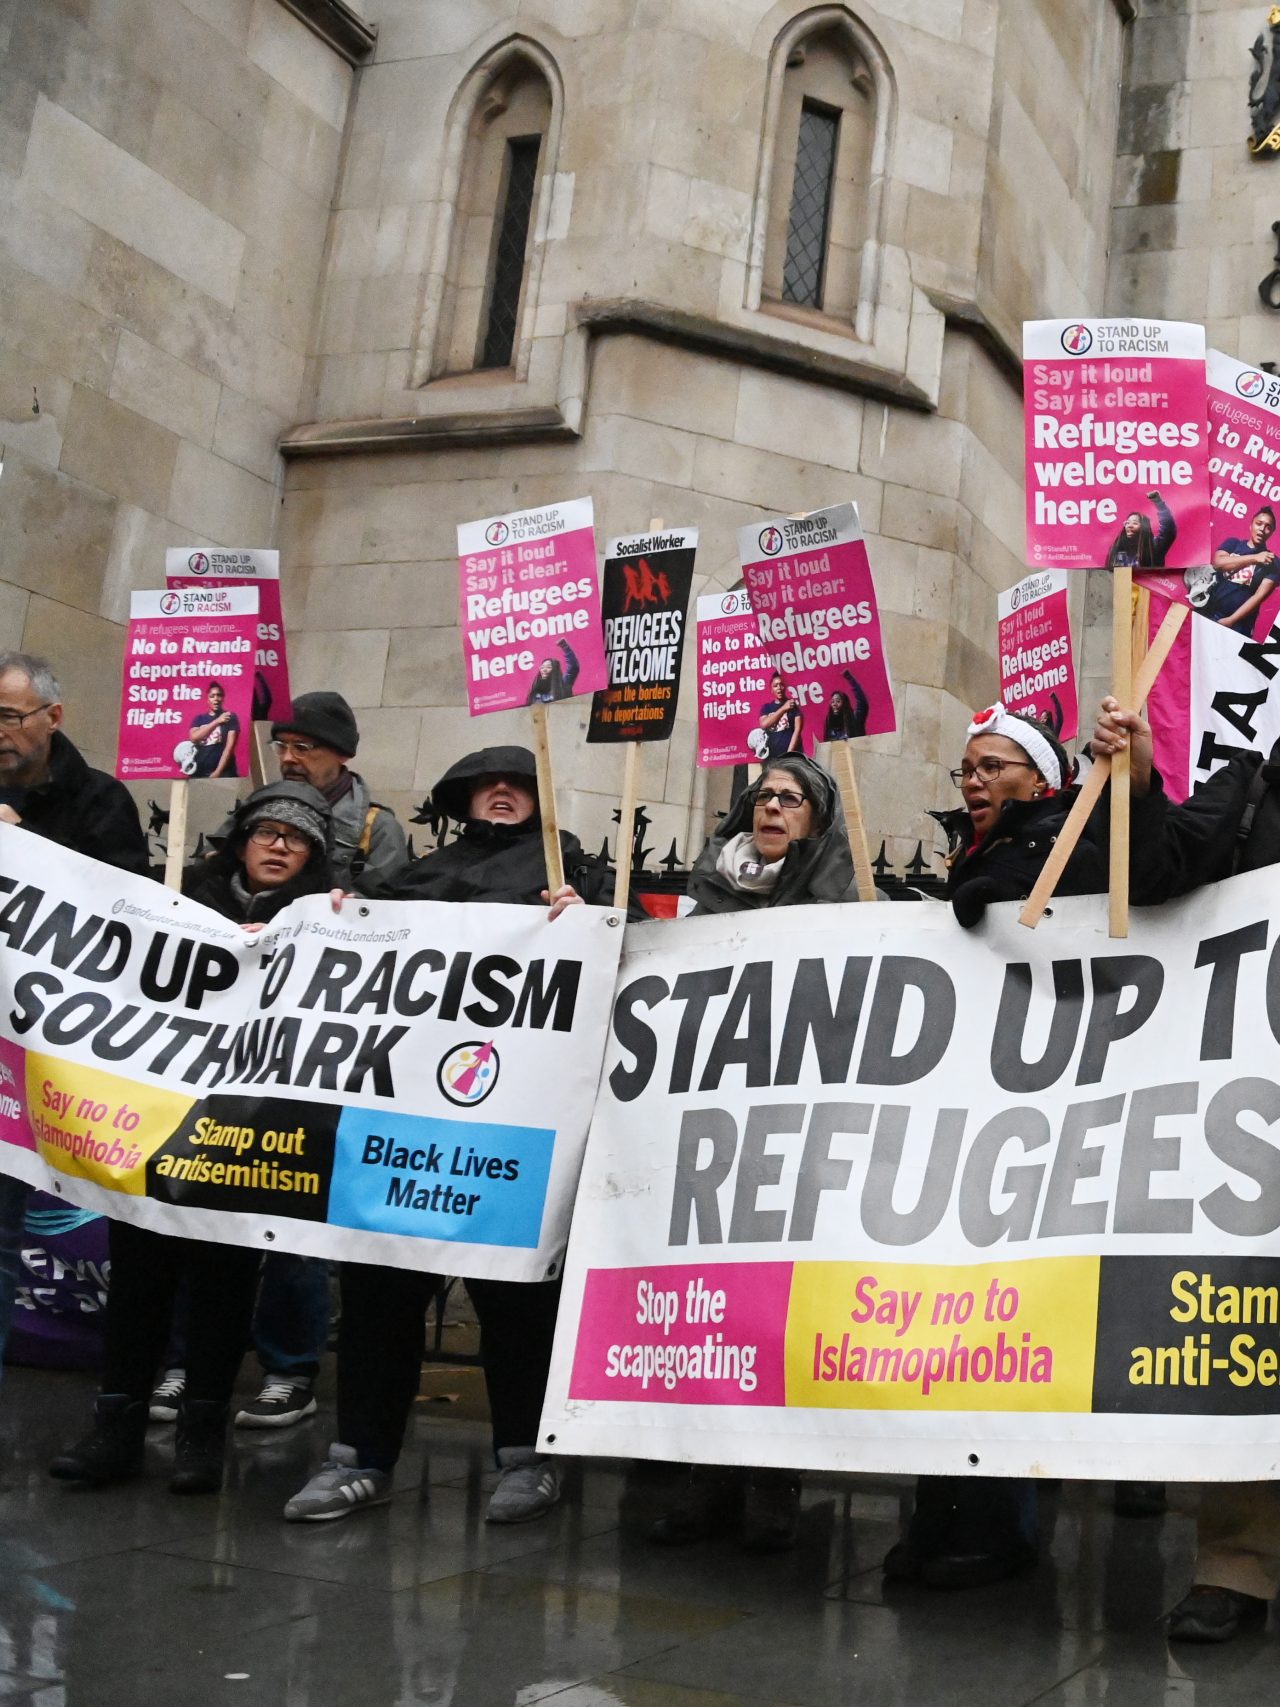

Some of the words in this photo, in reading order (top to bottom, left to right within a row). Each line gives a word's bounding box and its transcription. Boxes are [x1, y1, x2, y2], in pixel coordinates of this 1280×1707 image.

[1098, 326, 1139, 339] STAND
[1143, 327, 1161, 338] UP
[1099, 339, 1115, 352] TO
[1118, 339, 1169, 352] RACISM
[1034, 364, 1075, 387] Say
[1080, 364, 1098, 383] it
[1104, 363, 1152, 383] loud
[1034, 392, 1075, 414] Say
[1080, 391, 1098, 410] it
[1104, 391, 1169, 409] clear:
[1211, 401, 1262, 431] refugees
[1264, 392, 1280, 407] TO
[1034, 414, 1199, 454] Refugees
[1217, 423, 1240, 448] to
[1034, 452, 1192, 486] welcome
[1034, 492, 1117, 525] here
[1210, 486, 1247, 518] the
[466, 557, 496, 573] Say
[501, 550, 513, 566] it
[518, 541, 555, 562] loud
[617, 541, 651, 556] Socialist
[652, 536, 685, 550] Worker
[466, 576, 496, 592] Say
[502, 569, 514, 584] it
[519, 561, 567, 580] clear:
[467, 577, 592, 621] Refugees
[468, 609, 589, 650] welcome
[605, 610, 682, 650] REFUGEES
[758, 600, 872, 642] Refugees
[132, 639, 155, 655] No
[160, 639, 178, 654] to
[183, 637, 251, 653] Rwanda
[1002, 635, 1068, 679] Refugees
[130, 661, 242, 681] deportations
[472, 651, 534, 681] here
[703, 654, 771, 677] deportati
[128, 686, 168, 704] Stop
[173, 684, 202, 700] the
[639, 686, 671, 701] borders
[703, 681, 735, 697] Stop
[740, 676, 765, 692] the
[1003, 665, 1068, 704] welcome
[127, 709, 182, 728] flights
[615, 707, 664, 725] deportations
[703, 701, 750, 720] flights
[0, 875, 132, 984] AND
[139, 935, 239, 1011] UP
[298, 946, 582, 1032] RACISM
[10, 971, 411, 1099] SOUTHWARK
[607, 954, 957, 1102] STAND
[989, 954, 1166, 1095] UP
[42, 1080, 74, 1120] Say
[76, 1099, 108, 1122] no
[112, 1104, 140, 1131] to
[32, 1111, 142, 1169] Islamophobia
[188, 1117, 254, 1156] Stamp
[262, 1124, 304, 1156] out
[156, 1150, 320, 1195] antisemitism
[362, 1134, 442, 1175] Black
[450, 1145, 519, 1181] Lives
[385, 1180, 480, 1216] Matter
[636, 1279, 679, 1334] Stop
[685, 1278, 726, 1325] the
[851, 1275, 922, 1338] Say
[932, 1286, 974, 1326] no
[982, 1278, 1019, 1322] to
[606, 1334, 758, 1390] scapegoating
[813, 1333, 1052, 1396] Islamophobia
